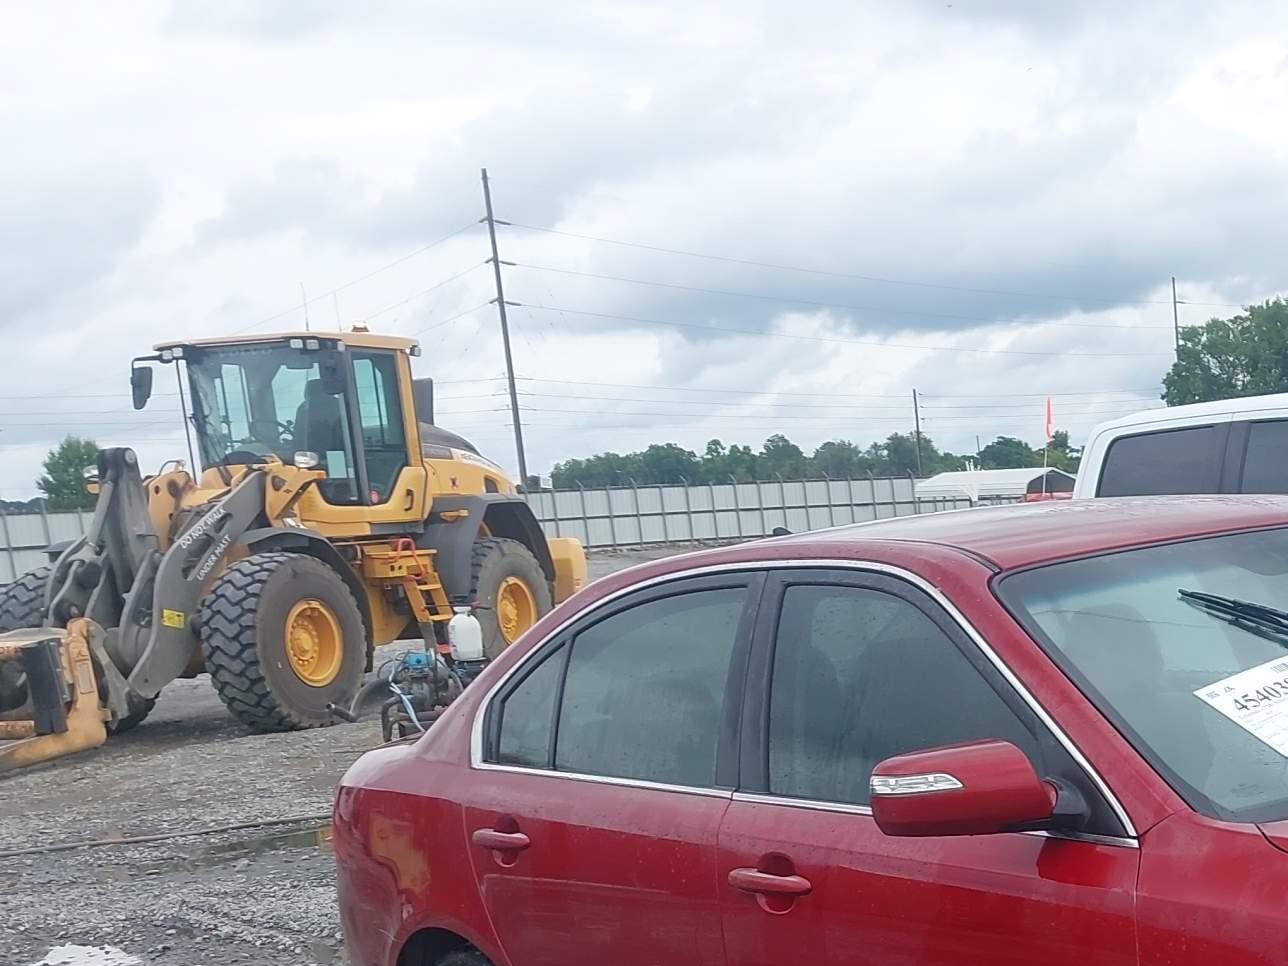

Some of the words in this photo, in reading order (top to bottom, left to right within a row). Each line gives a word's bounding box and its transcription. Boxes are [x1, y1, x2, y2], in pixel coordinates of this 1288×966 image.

[180, 535, 193, 549] DO
[207, 506, 227, 526] WALK
[196, 554, 218, 581] UNDER
[213, 534, 232, 557] MAST
